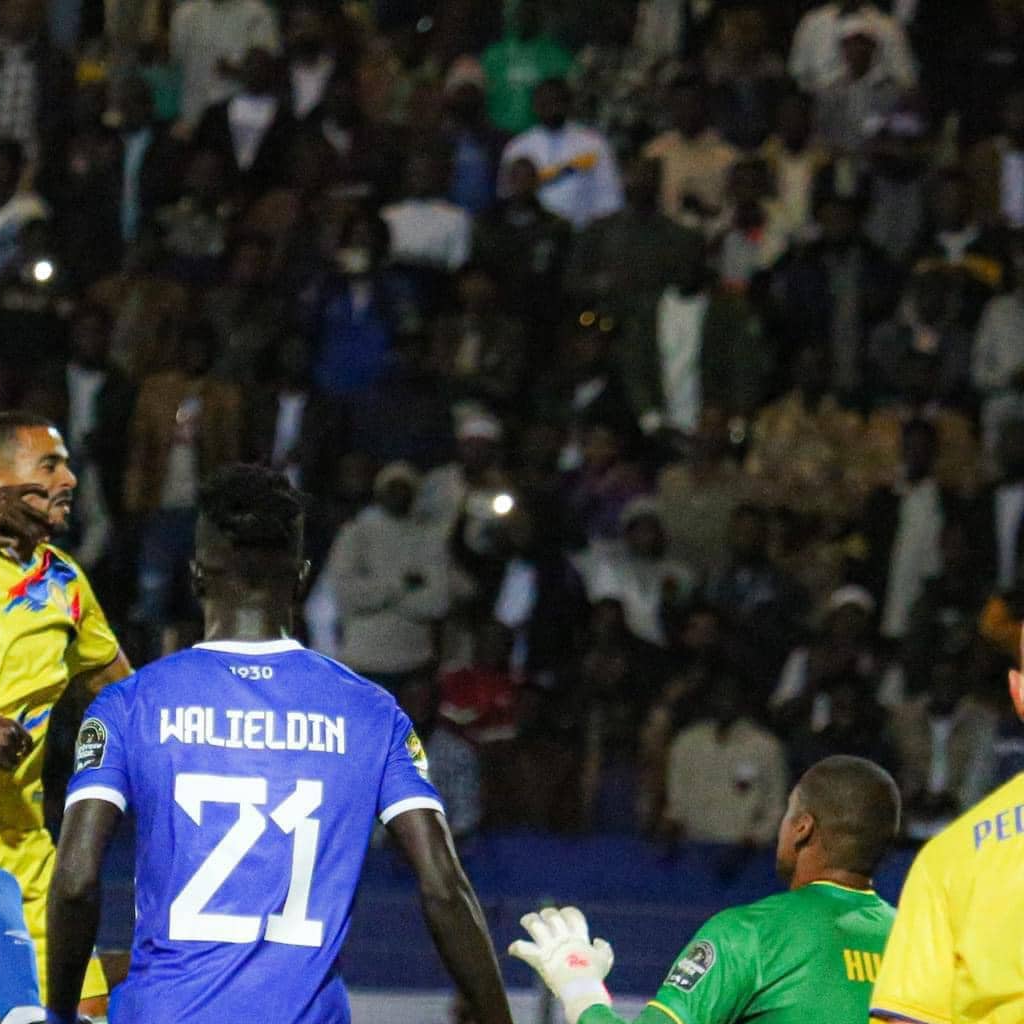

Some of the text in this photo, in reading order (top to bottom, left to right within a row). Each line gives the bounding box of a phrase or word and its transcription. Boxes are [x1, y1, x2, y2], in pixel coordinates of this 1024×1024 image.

[229, 665, 273, 680] 1930
[159, 706, 345, 754] WALIELDIN
[169, 773, 324, 947] 21
